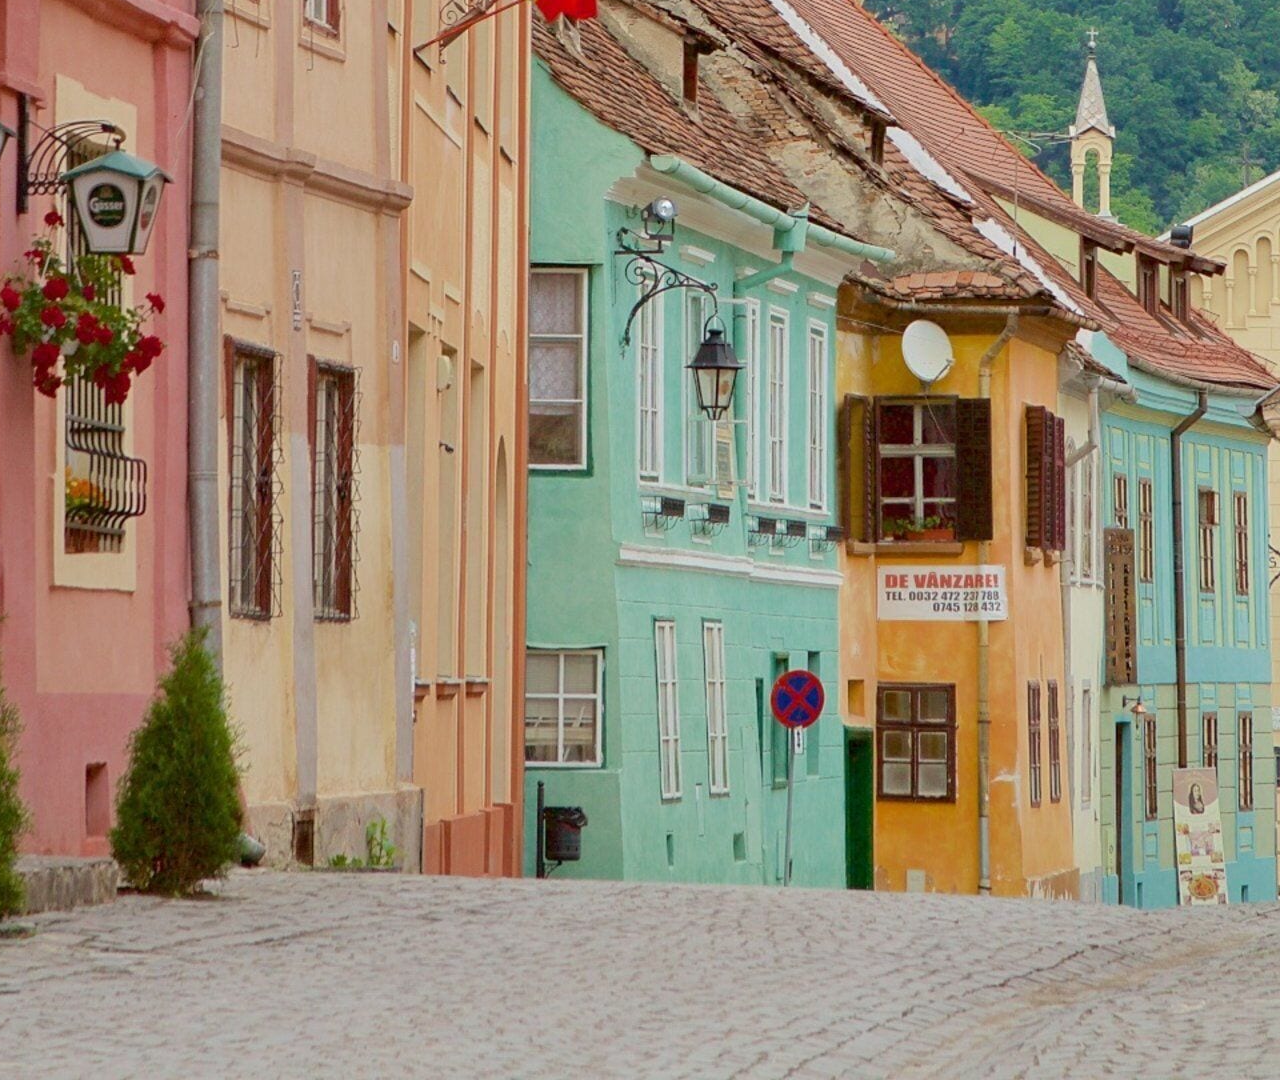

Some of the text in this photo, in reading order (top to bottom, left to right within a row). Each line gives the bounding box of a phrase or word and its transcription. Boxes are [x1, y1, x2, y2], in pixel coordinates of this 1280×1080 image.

[885, 571, 999, 589] DE VÂNZARE!
[885, 591, 907, 601] TEL.
[908, 591, 939, 601] 0032
[940, 591, 960, 601] 472
[963, 591, 979, 601] 237
[933, 602, 1001, 613] 0745 128 432
